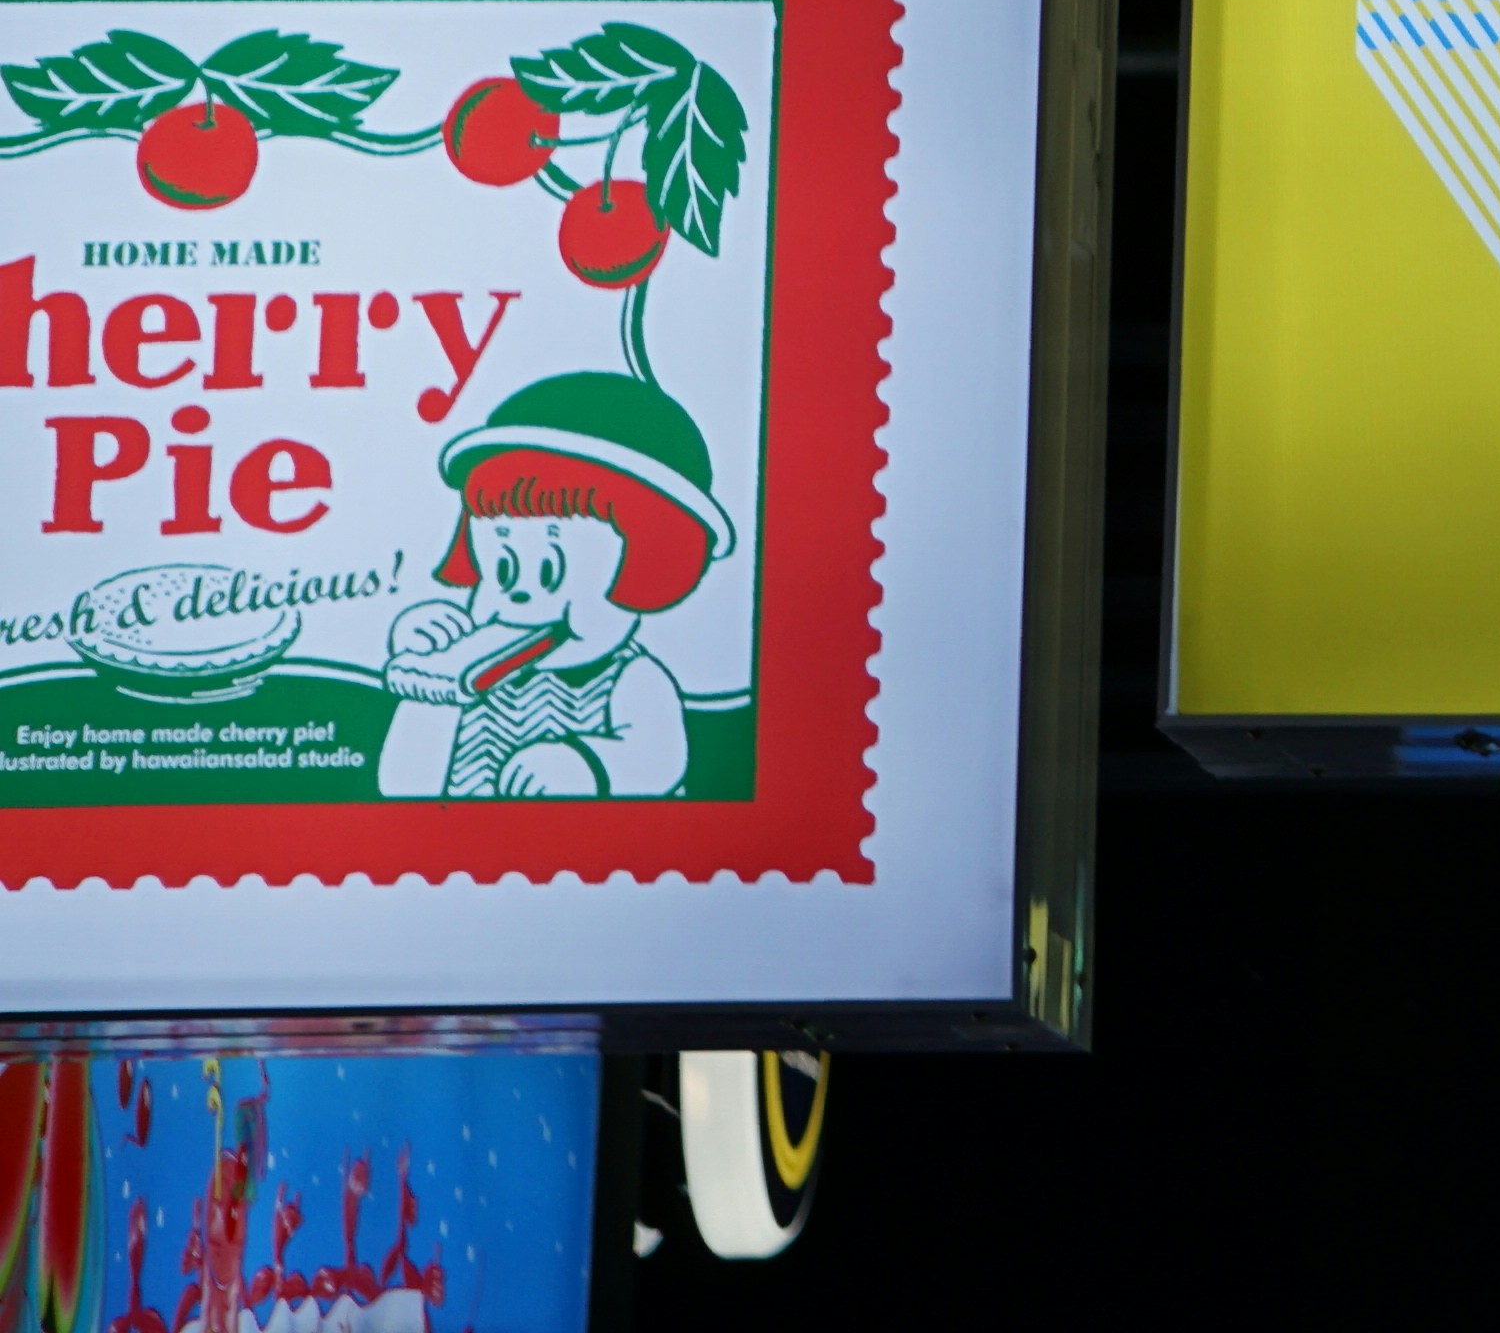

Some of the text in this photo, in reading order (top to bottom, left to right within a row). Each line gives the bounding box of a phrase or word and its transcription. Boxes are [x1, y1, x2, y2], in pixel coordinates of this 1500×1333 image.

[82, 240, 321, 267] HOME MADE
[41, 405, 333, 536] Pie
[173, 548, 403, 623] delicious!
[16, 721, 335, 749] Enjoy home made cherry pie!
[100, 749, 127, 774] by
[131, 748, 293, 771] hawaiiansalad
[298, 748, 366, 769] studio
